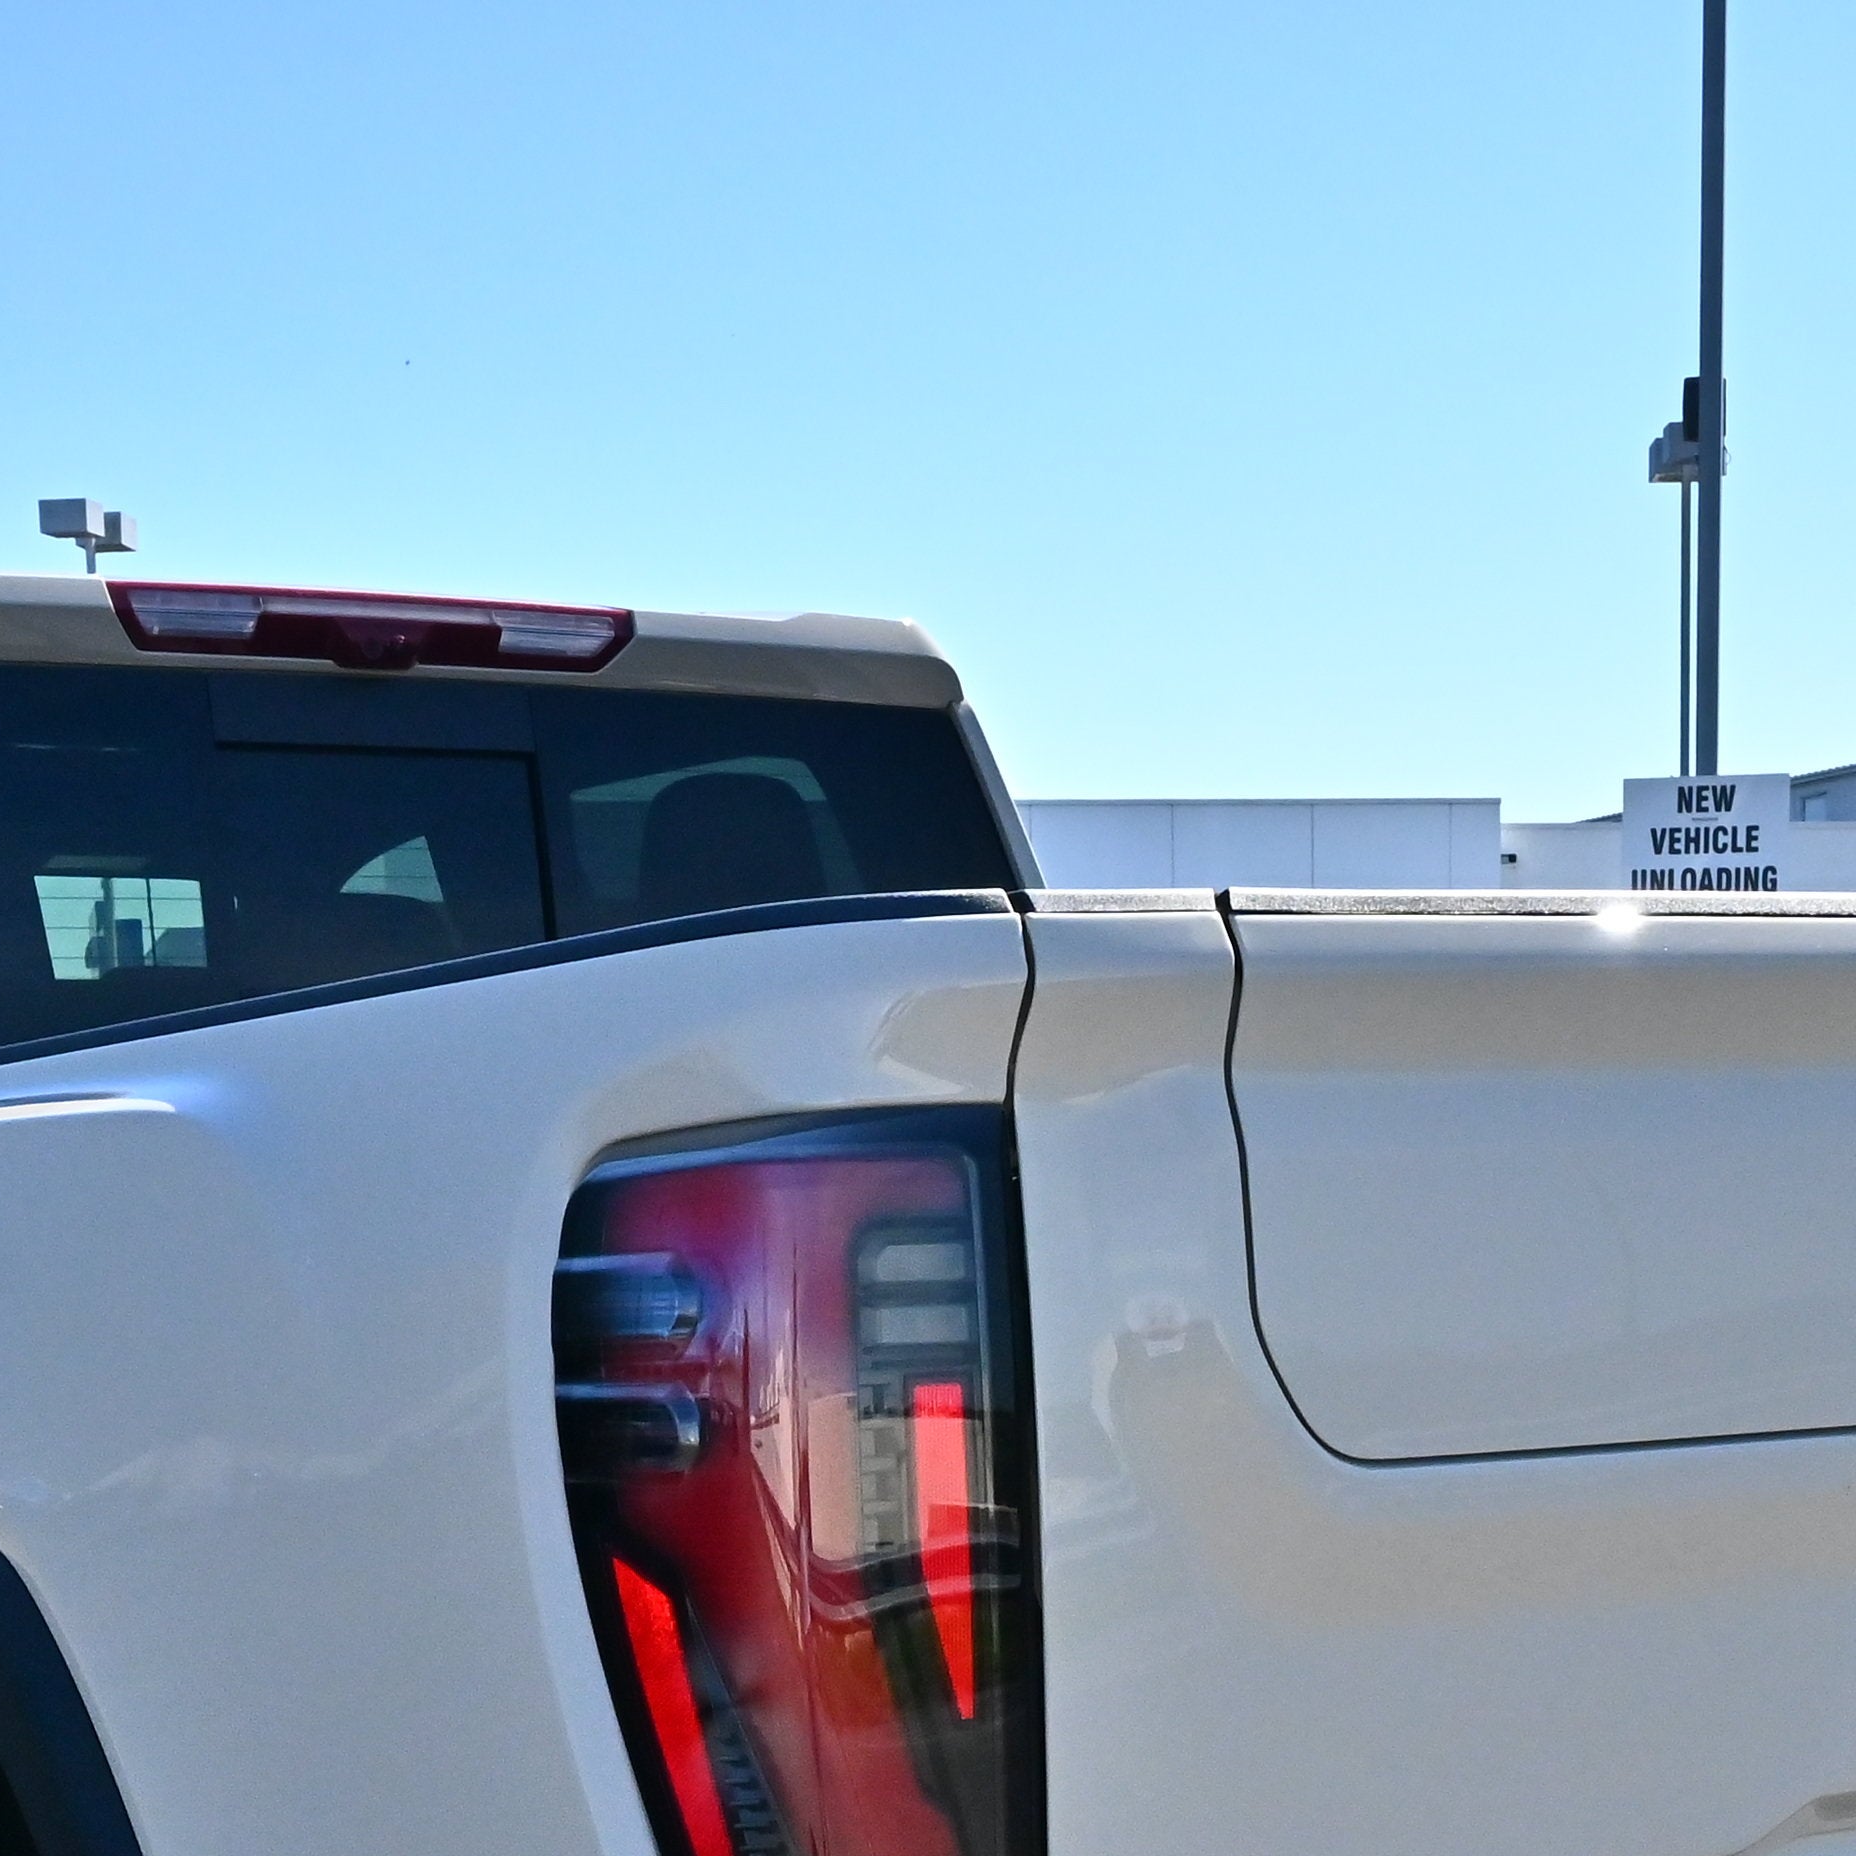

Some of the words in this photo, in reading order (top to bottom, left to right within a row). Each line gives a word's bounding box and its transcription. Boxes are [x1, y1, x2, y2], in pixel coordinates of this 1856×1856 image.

[1677, 784, 1736, 814] NEW
[1650, 825, 1760, 855] VEHICLE
[1631, 865, 1778, 892] UNLOADING
